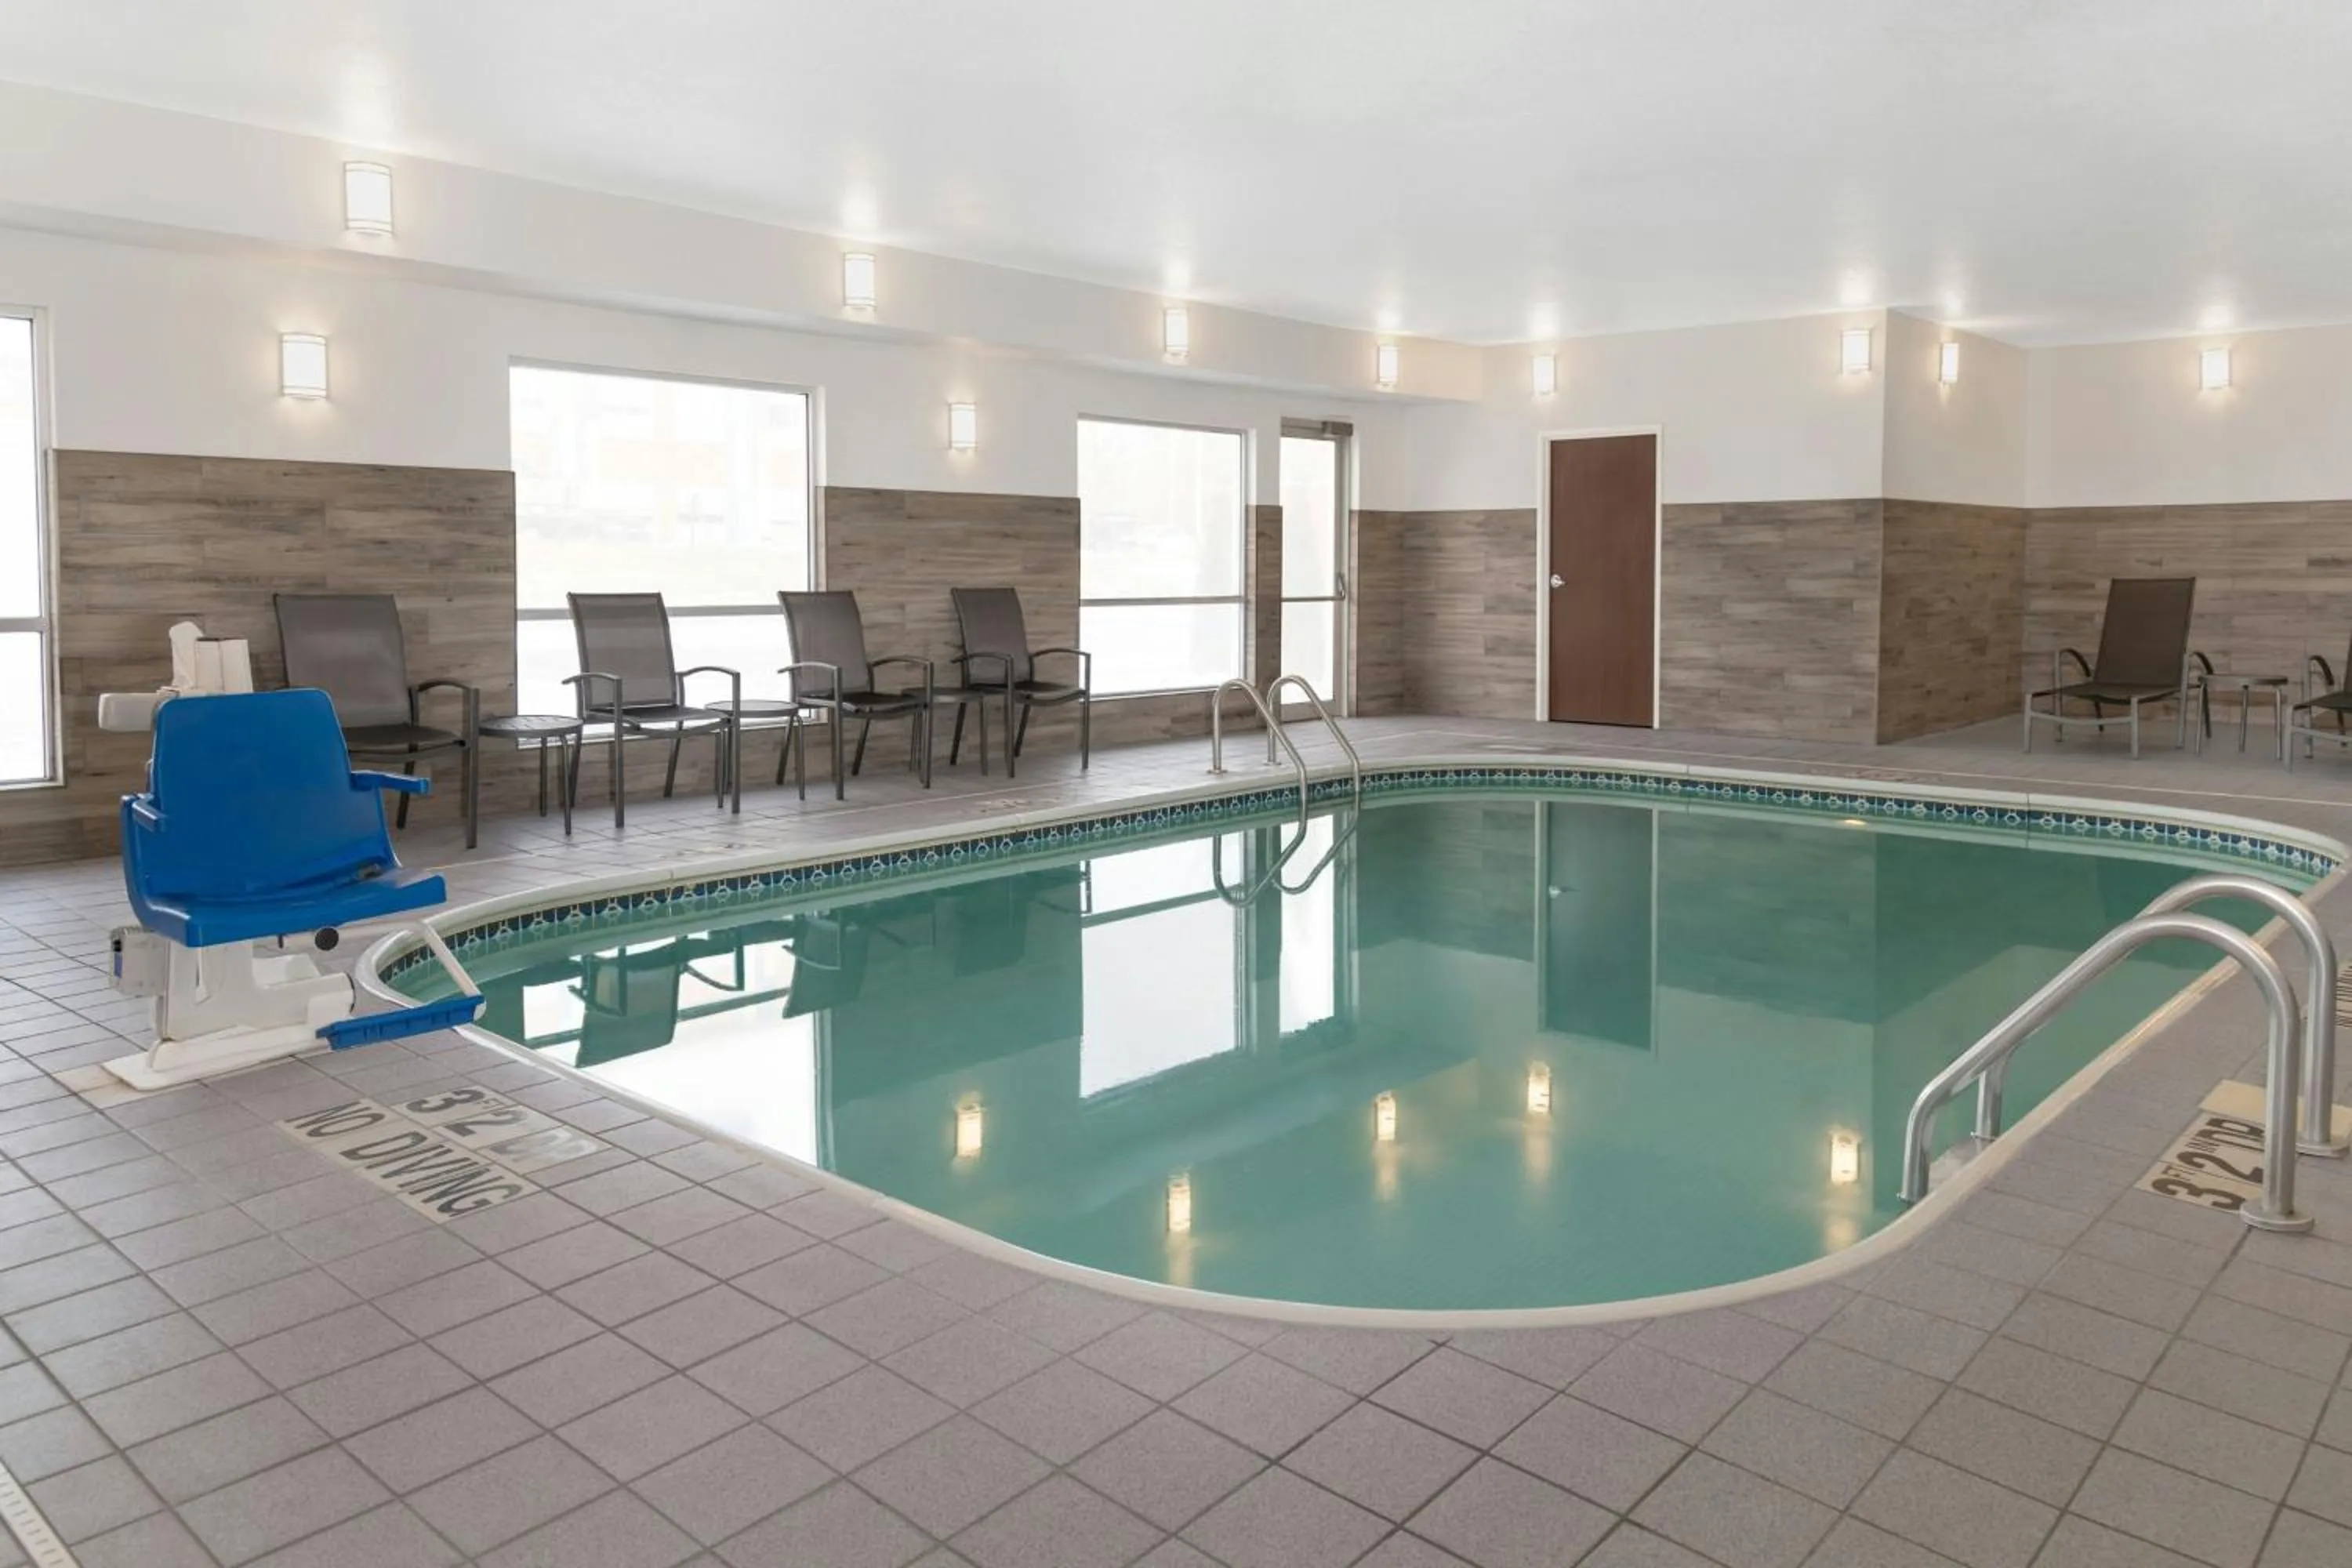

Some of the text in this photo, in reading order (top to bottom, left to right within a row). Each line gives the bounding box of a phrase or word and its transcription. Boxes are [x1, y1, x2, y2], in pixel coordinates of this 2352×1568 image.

[405, 1088, 485, 1113] 3
[444, 1109, 528, 1137] 2
[284, 1101, 523, 1218] NO DIVING
[2176, 1151, 2263, 1184] 2
[2151, 1177, 2246, 1211] 3
